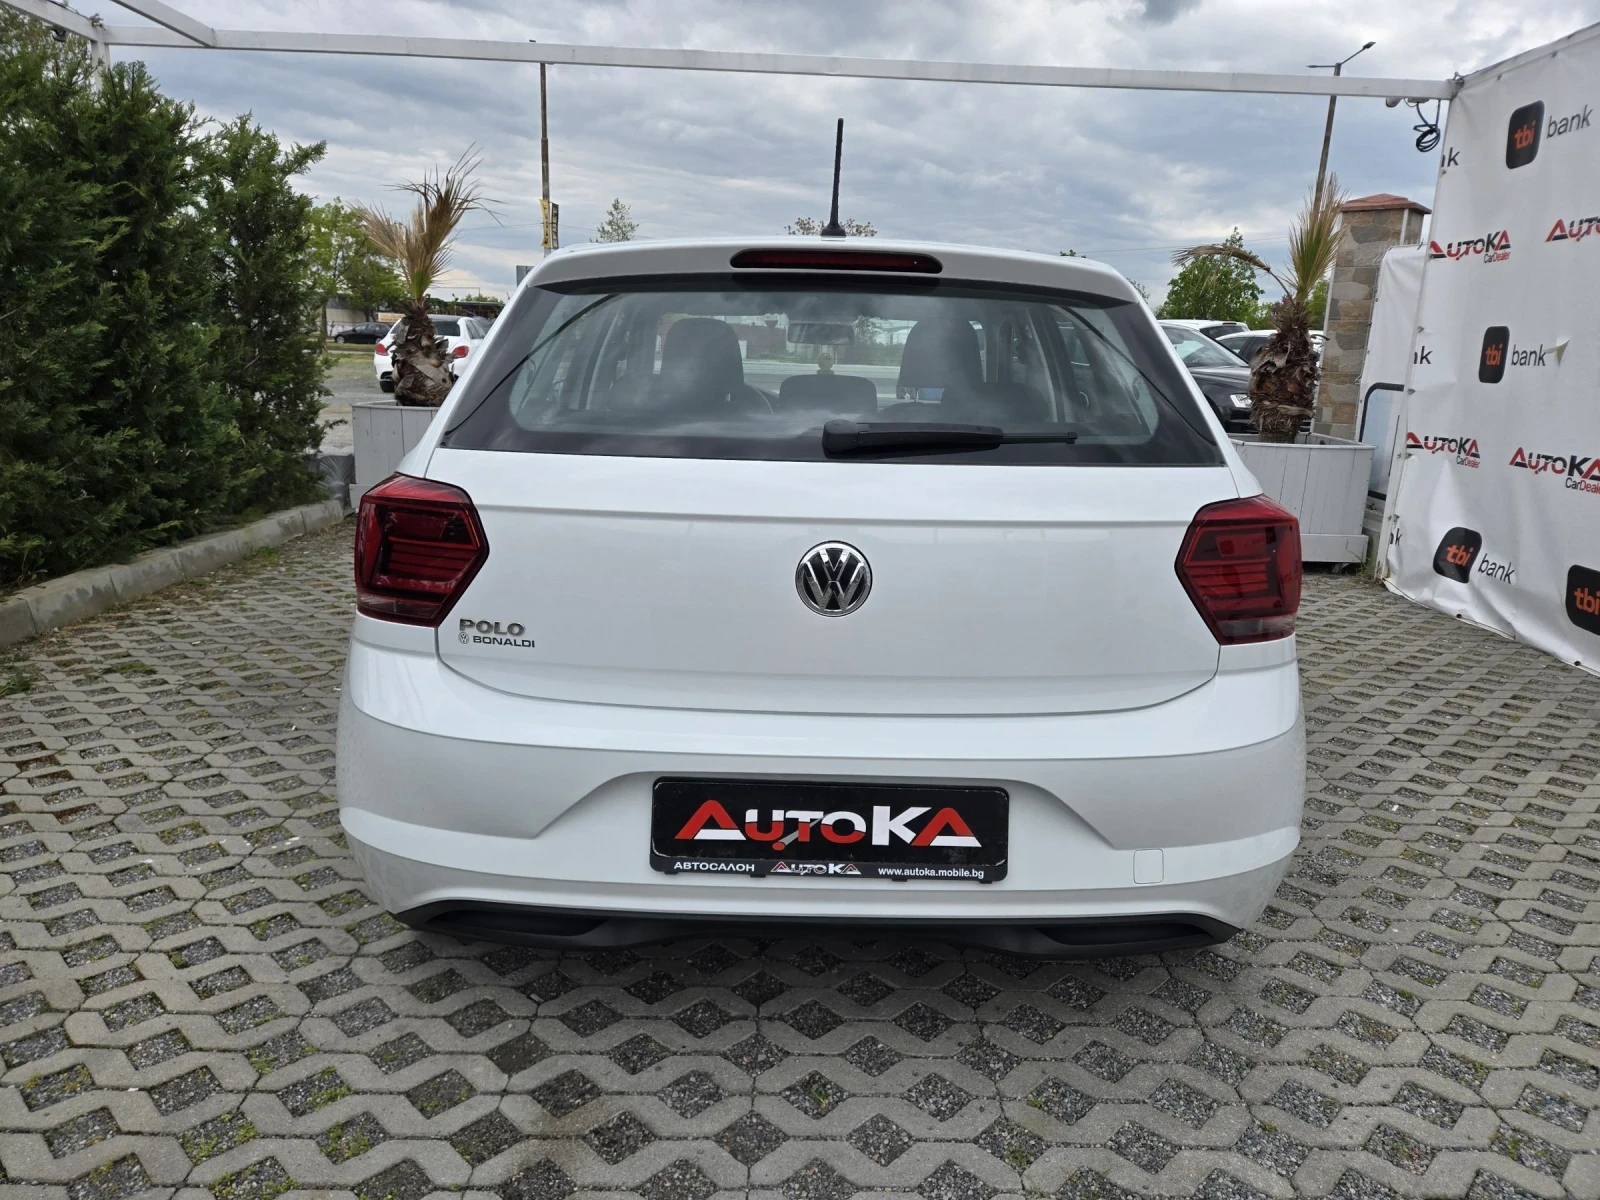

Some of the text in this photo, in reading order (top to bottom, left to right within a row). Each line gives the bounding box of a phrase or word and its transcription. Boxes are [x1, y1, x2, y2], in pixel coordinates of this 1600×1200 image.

[1514, 103, 1593, 149] tbi bank
[1544, 216, 1600, 242] AUT
[1485, 343, 1547, 367] tbi bank
[1446, 544, 1515, 584] tbi bank
[1573, 587, 1600, 616] tbi
[459, 618, 526, 637] POLO
[473, 635, 535, 648] BONALDI
[673, 861, 755, 873] АВТОСАЛОН
[878, 866, 985, 880] www.autoka.mobile.bg
